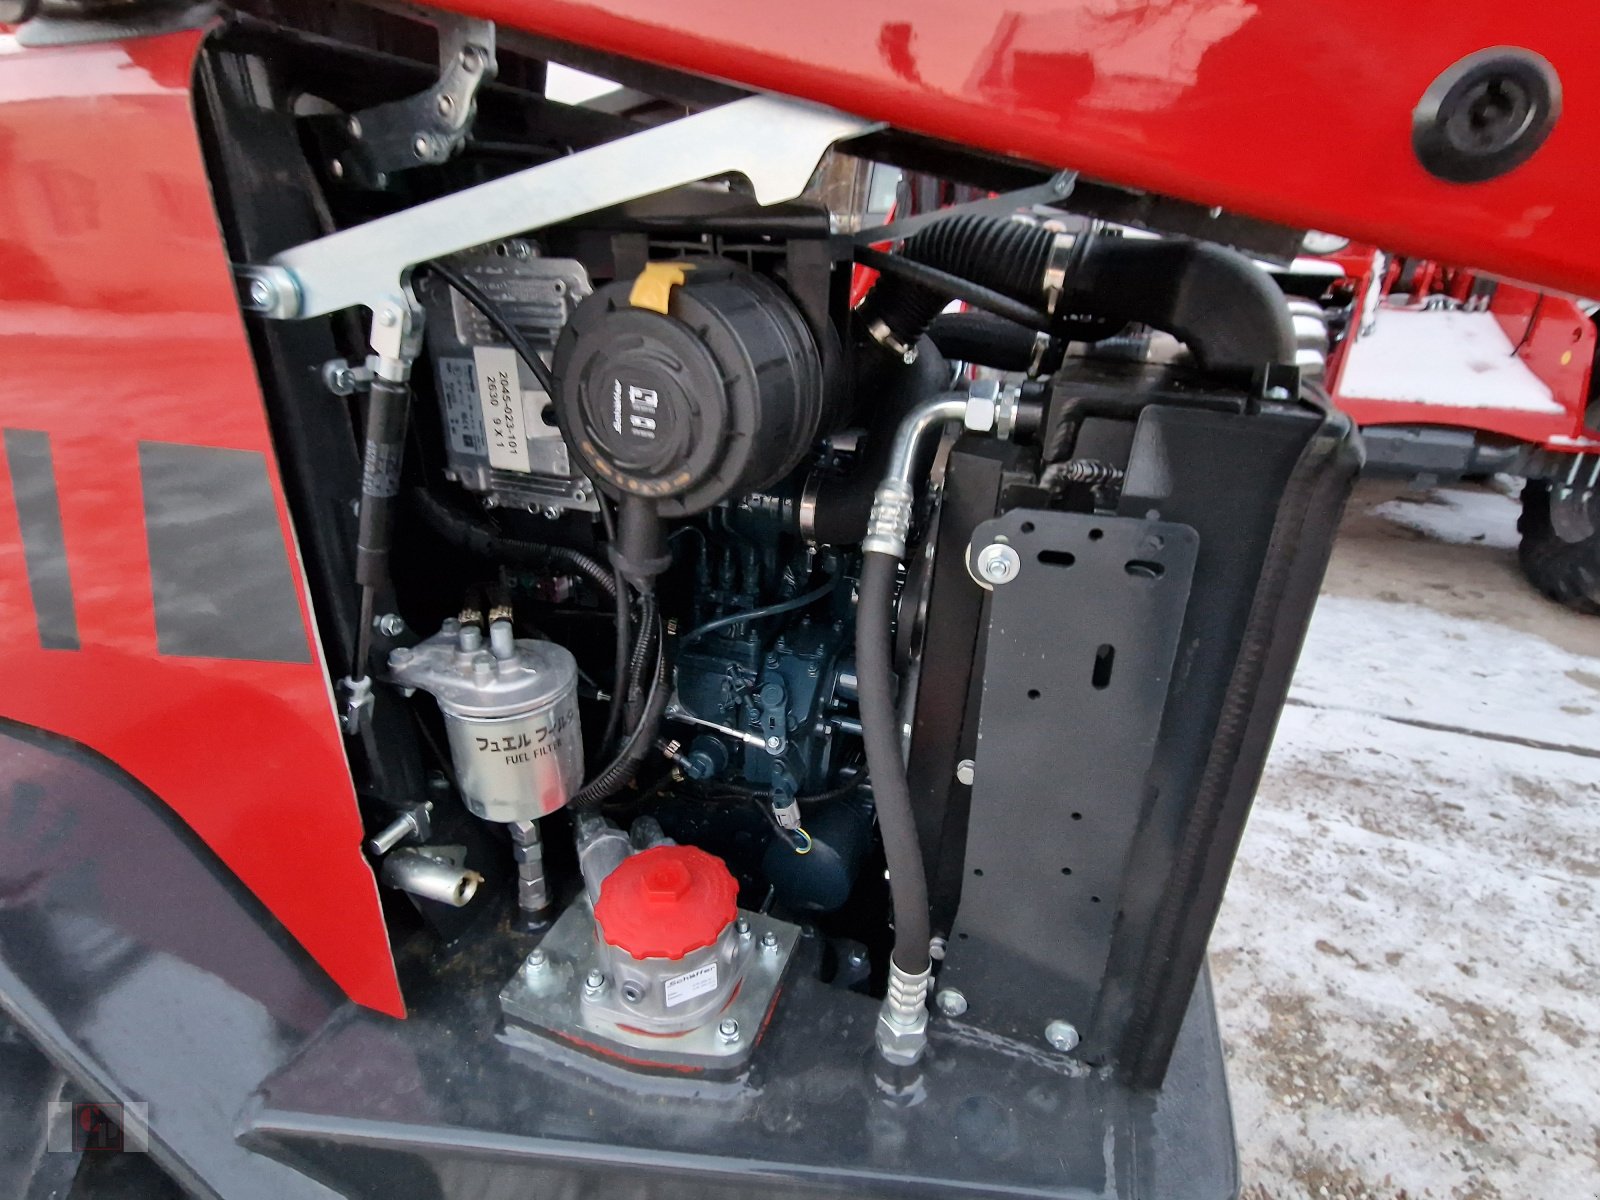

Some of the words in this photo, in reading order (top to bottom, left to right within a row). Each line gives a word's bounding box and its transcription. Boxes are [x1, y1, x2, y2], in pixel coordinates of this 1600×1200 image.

[487, 375, 499, 406] 2630
[499, 371, 518, 455] 2045-023-101
[476, 733, 531, 752] フュエル
[505, 751, 530, 765] FUEL
[533, 738, 562, 759] FILTER
